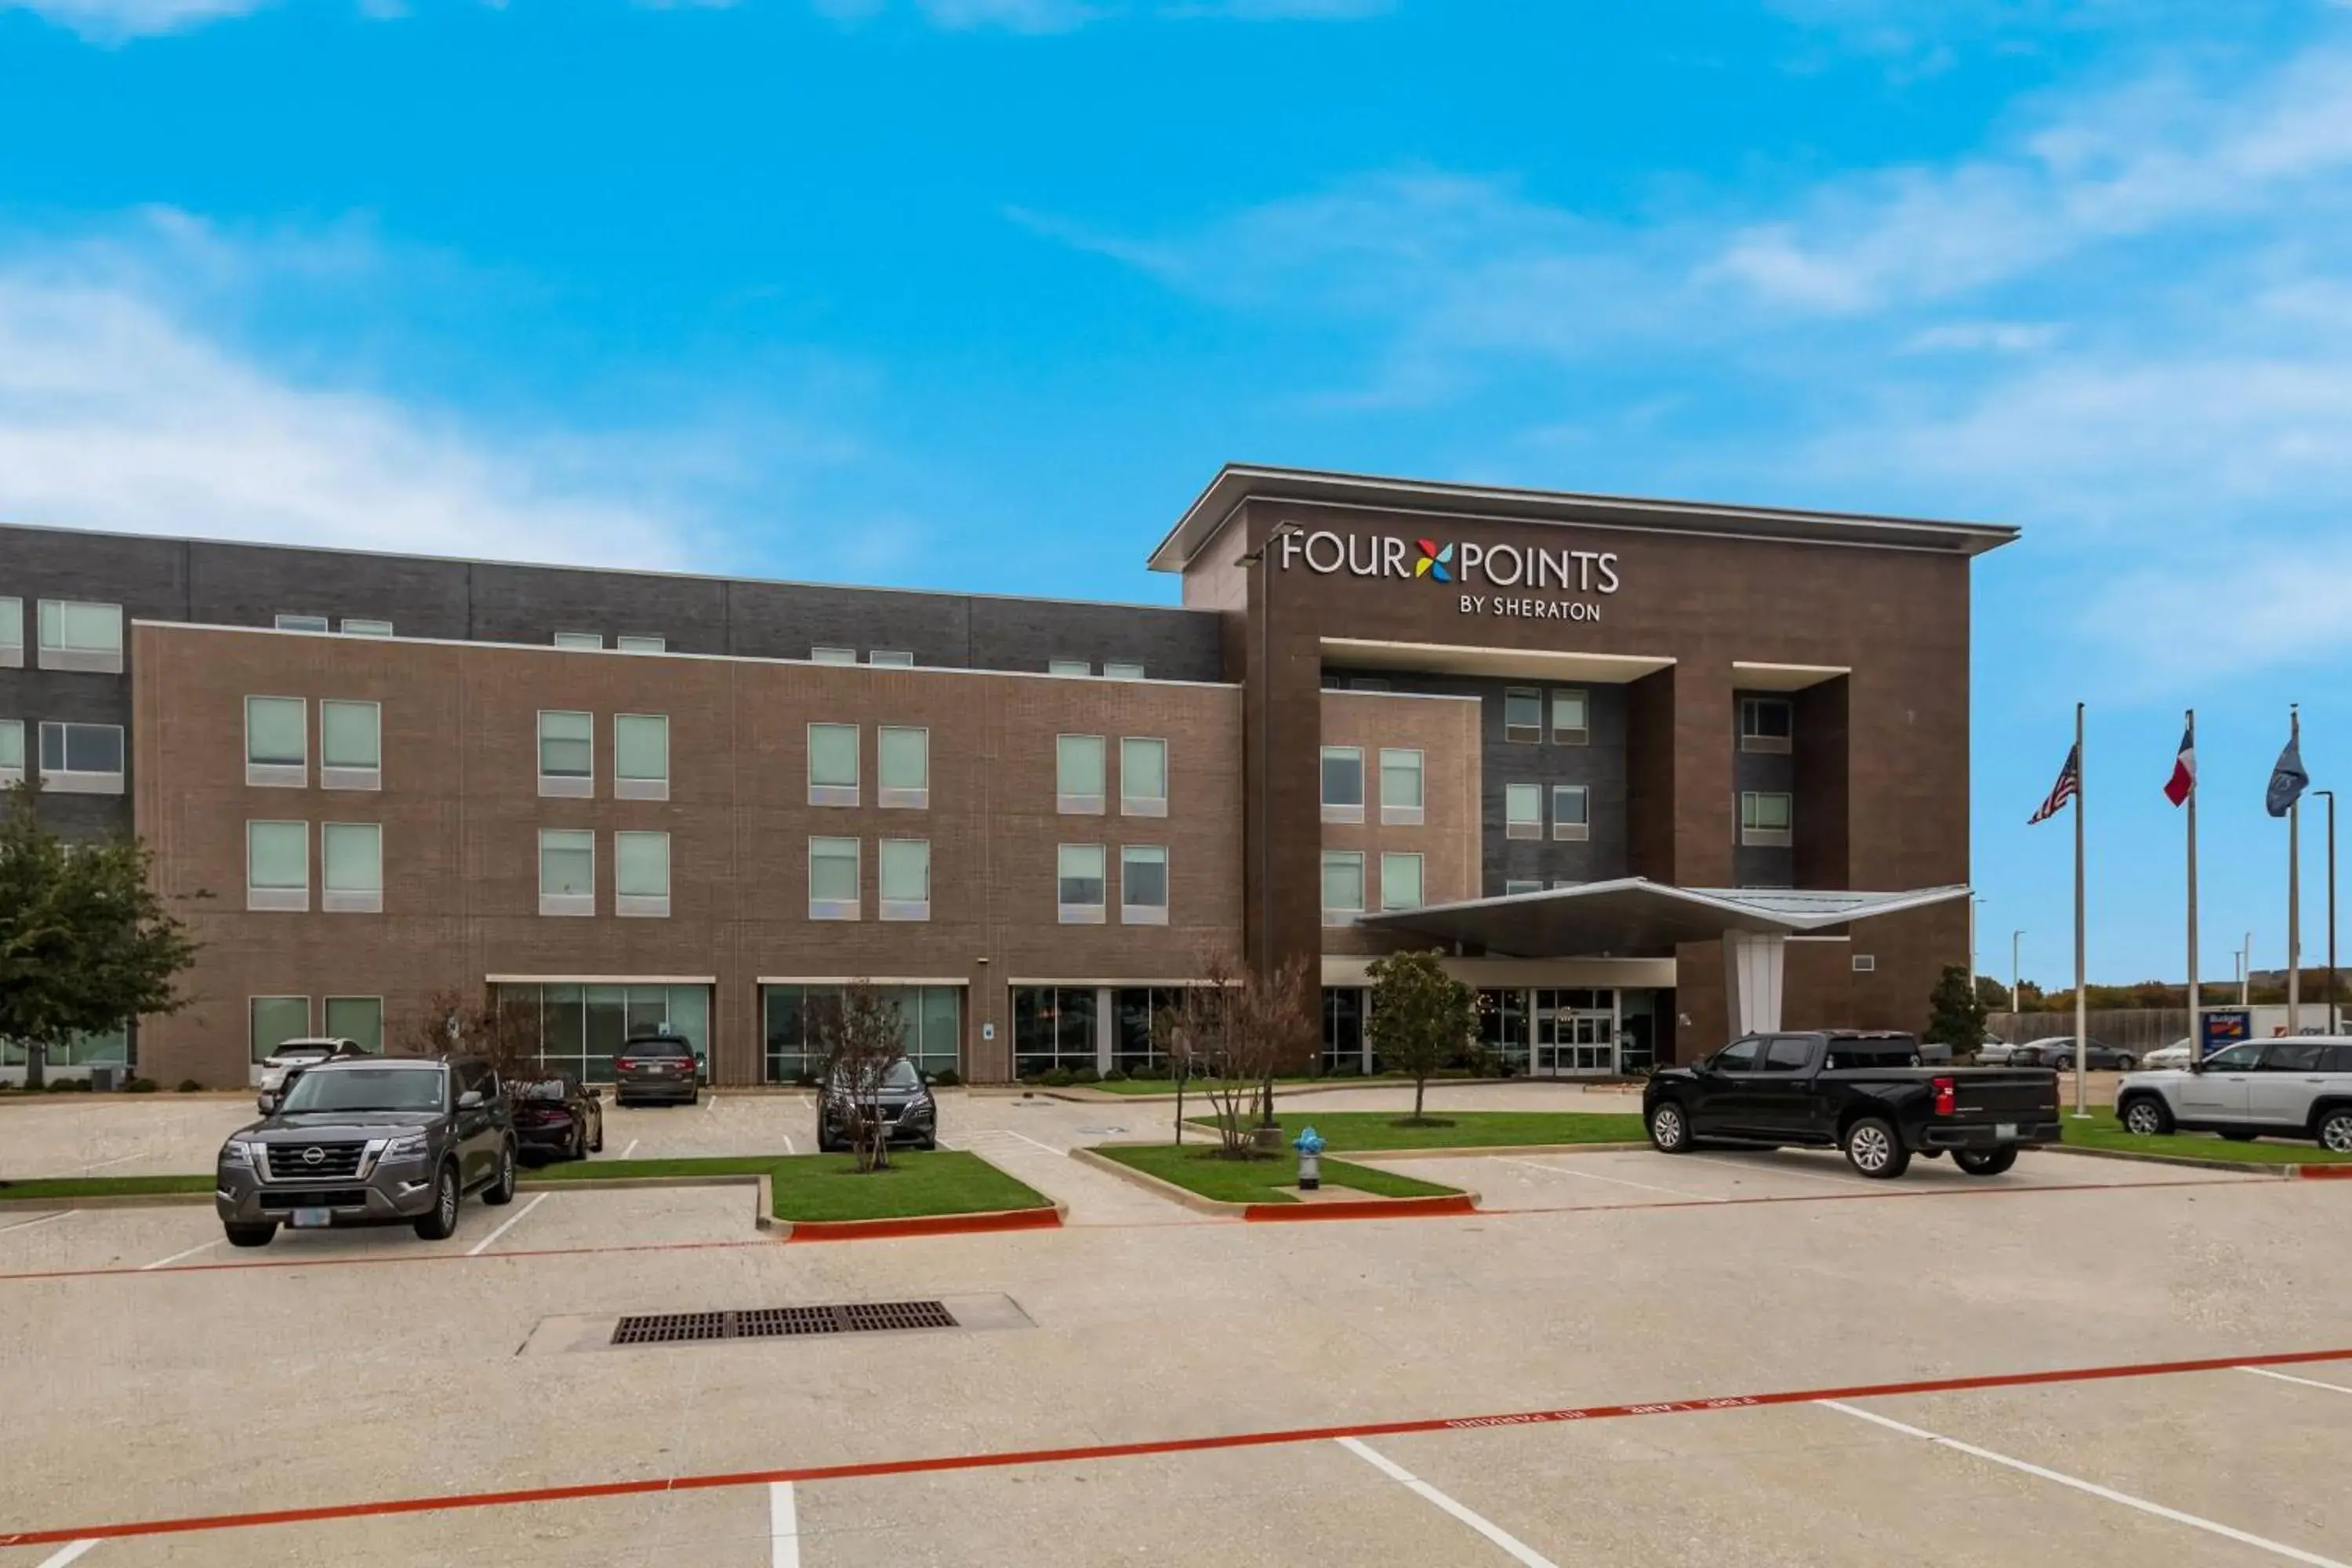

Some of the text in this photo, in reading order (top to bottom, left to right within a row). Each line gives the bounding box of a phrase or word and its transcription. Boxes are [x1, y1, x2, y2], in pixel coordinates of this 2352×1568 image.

[1281, 528, 1619, 593] FOUR POINTS
[1460, 594, 1601, 622] BY SHERATON
